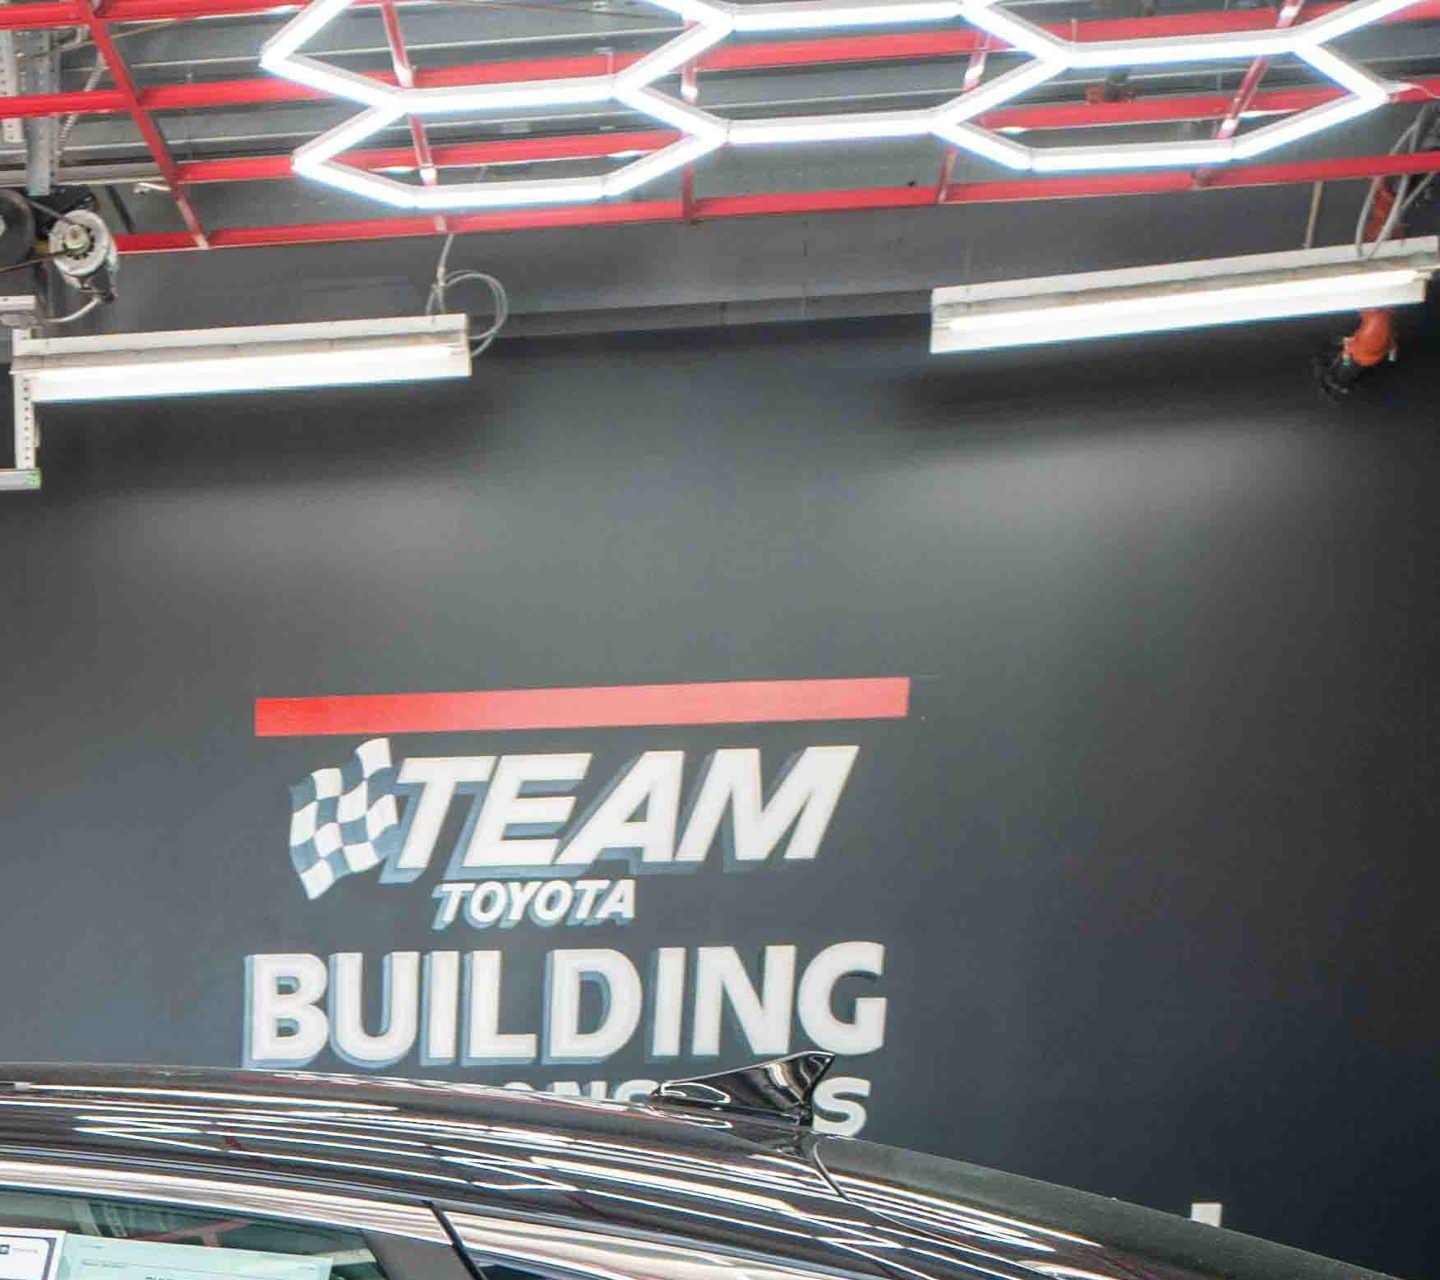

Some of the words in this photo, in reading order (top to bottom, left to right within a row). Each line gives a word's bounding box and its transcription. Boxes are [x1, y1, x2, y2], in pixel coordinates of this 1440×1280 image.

[385, 744, 860, 877] TEAM
[432, 878, 637, 930] TOYOTA
[245, 941, 888, 1068] BUILDING
